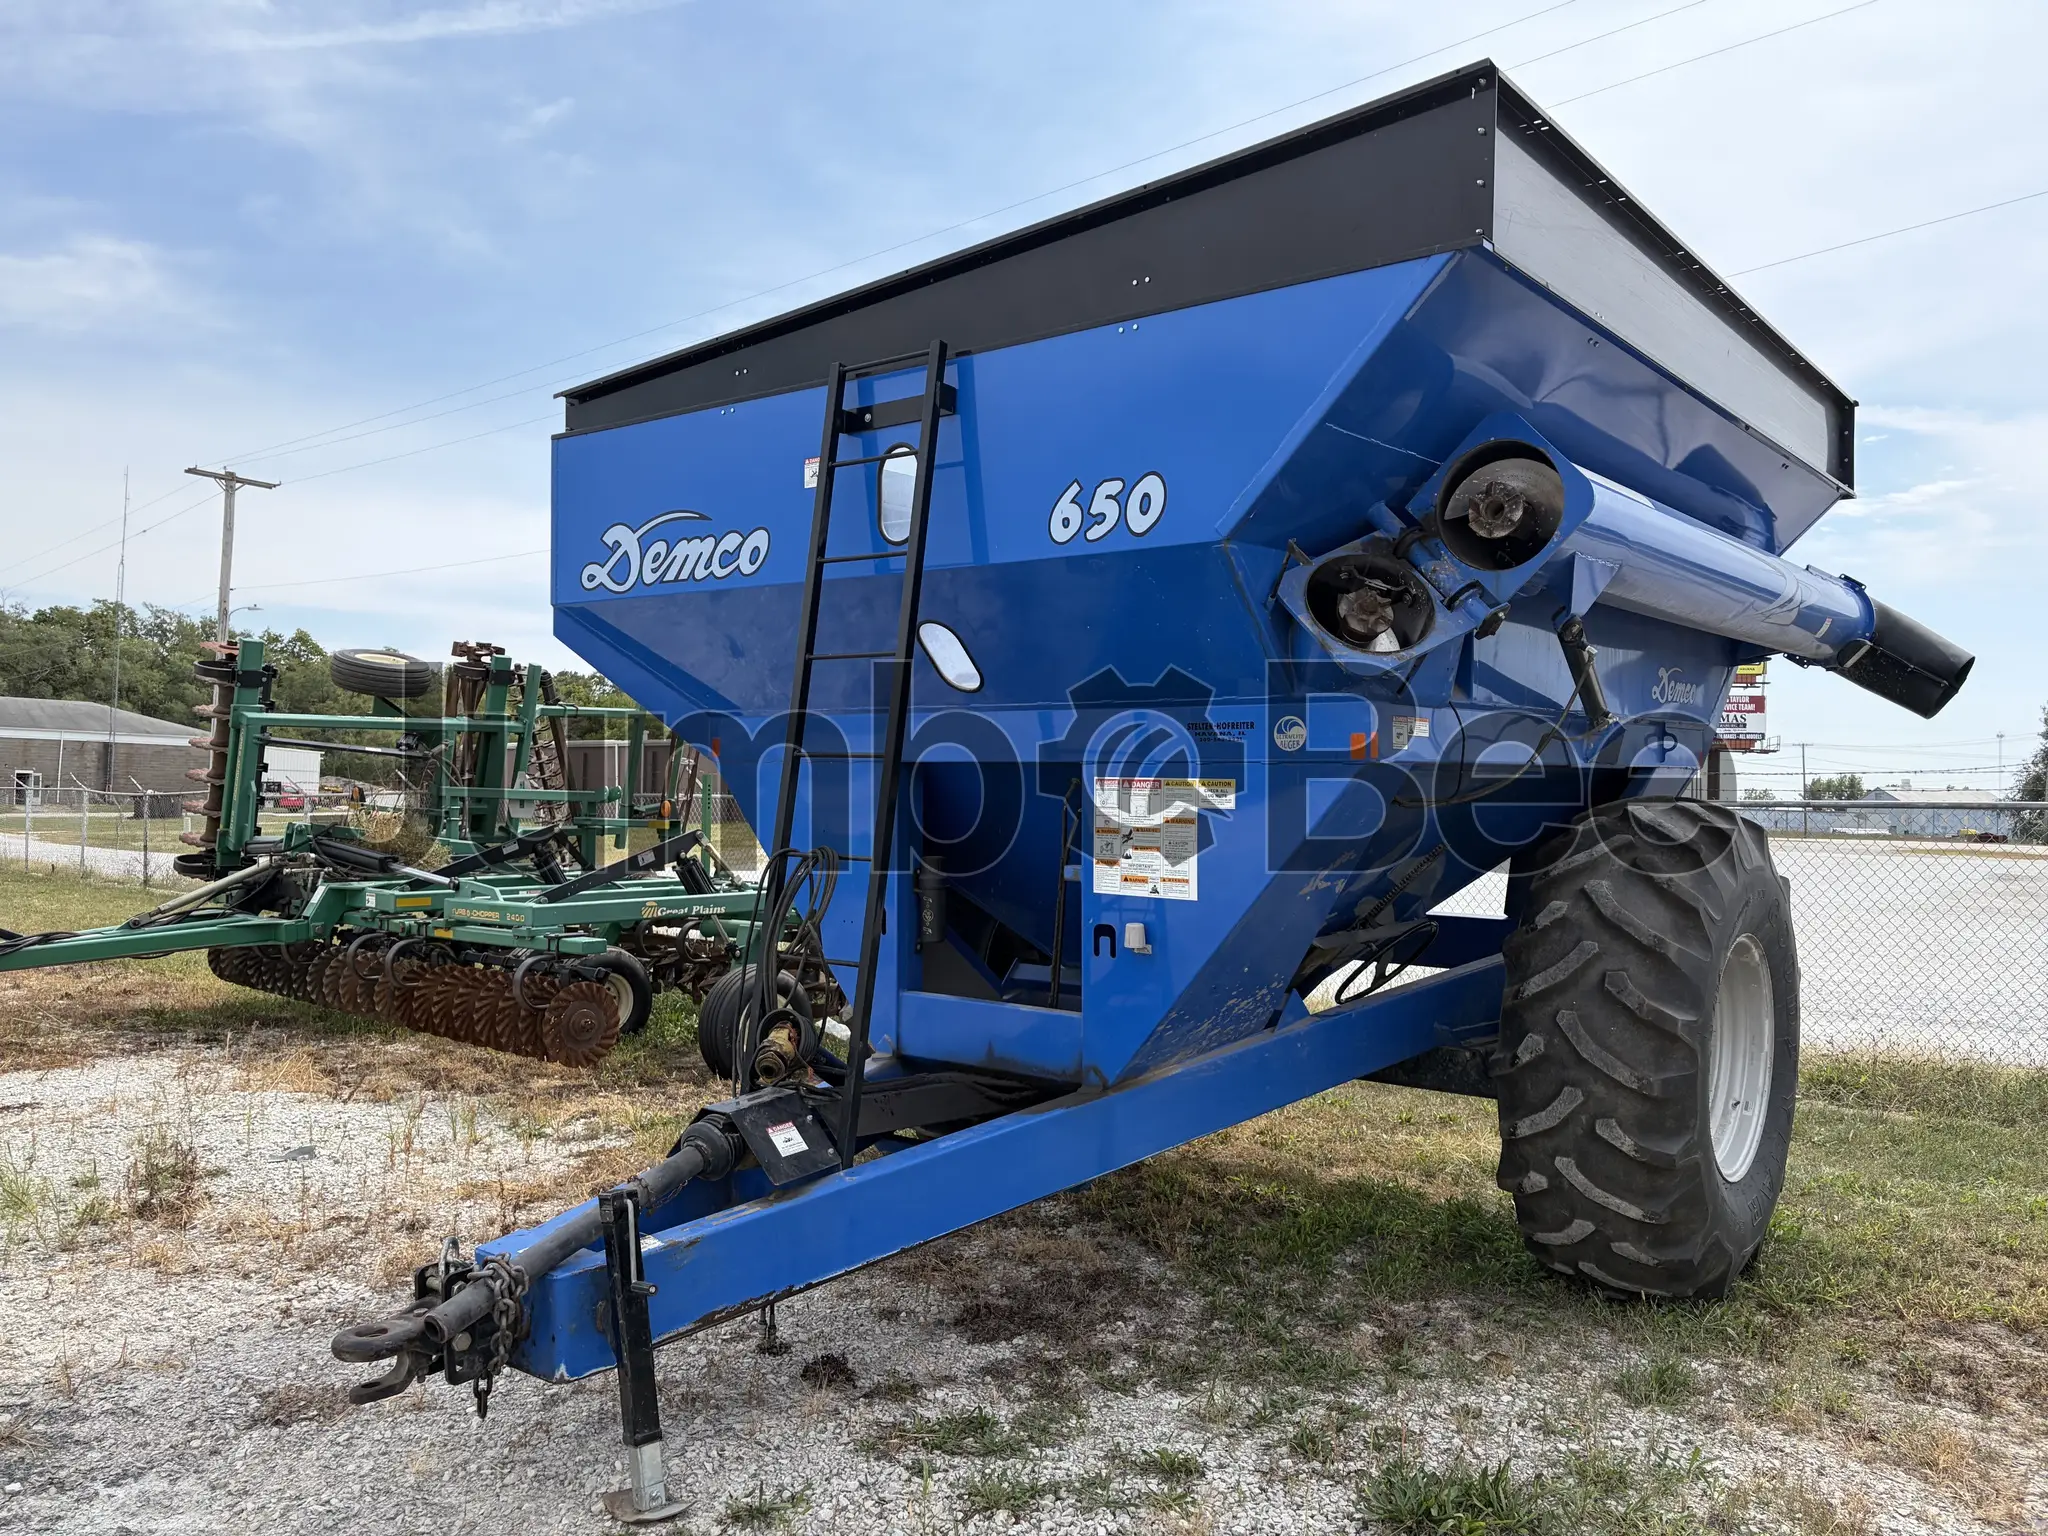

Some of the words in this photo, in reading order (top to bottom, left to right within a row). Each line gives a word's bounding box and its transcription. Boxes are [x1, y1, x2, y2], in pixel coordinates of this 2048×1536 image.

[1048, 471, 1167, 545] 650
[580, 510, 771, 594] Demco
[1651, 666, 1697, 704] Demco
[1738, 703, 1756, 711] TEAM!
[1279, 740, 1301, 750] AUGER
[657, 905, 688, 916] Great
[691, 904, 726, 915] Plains
[506, 912, 525, 922] 2400
